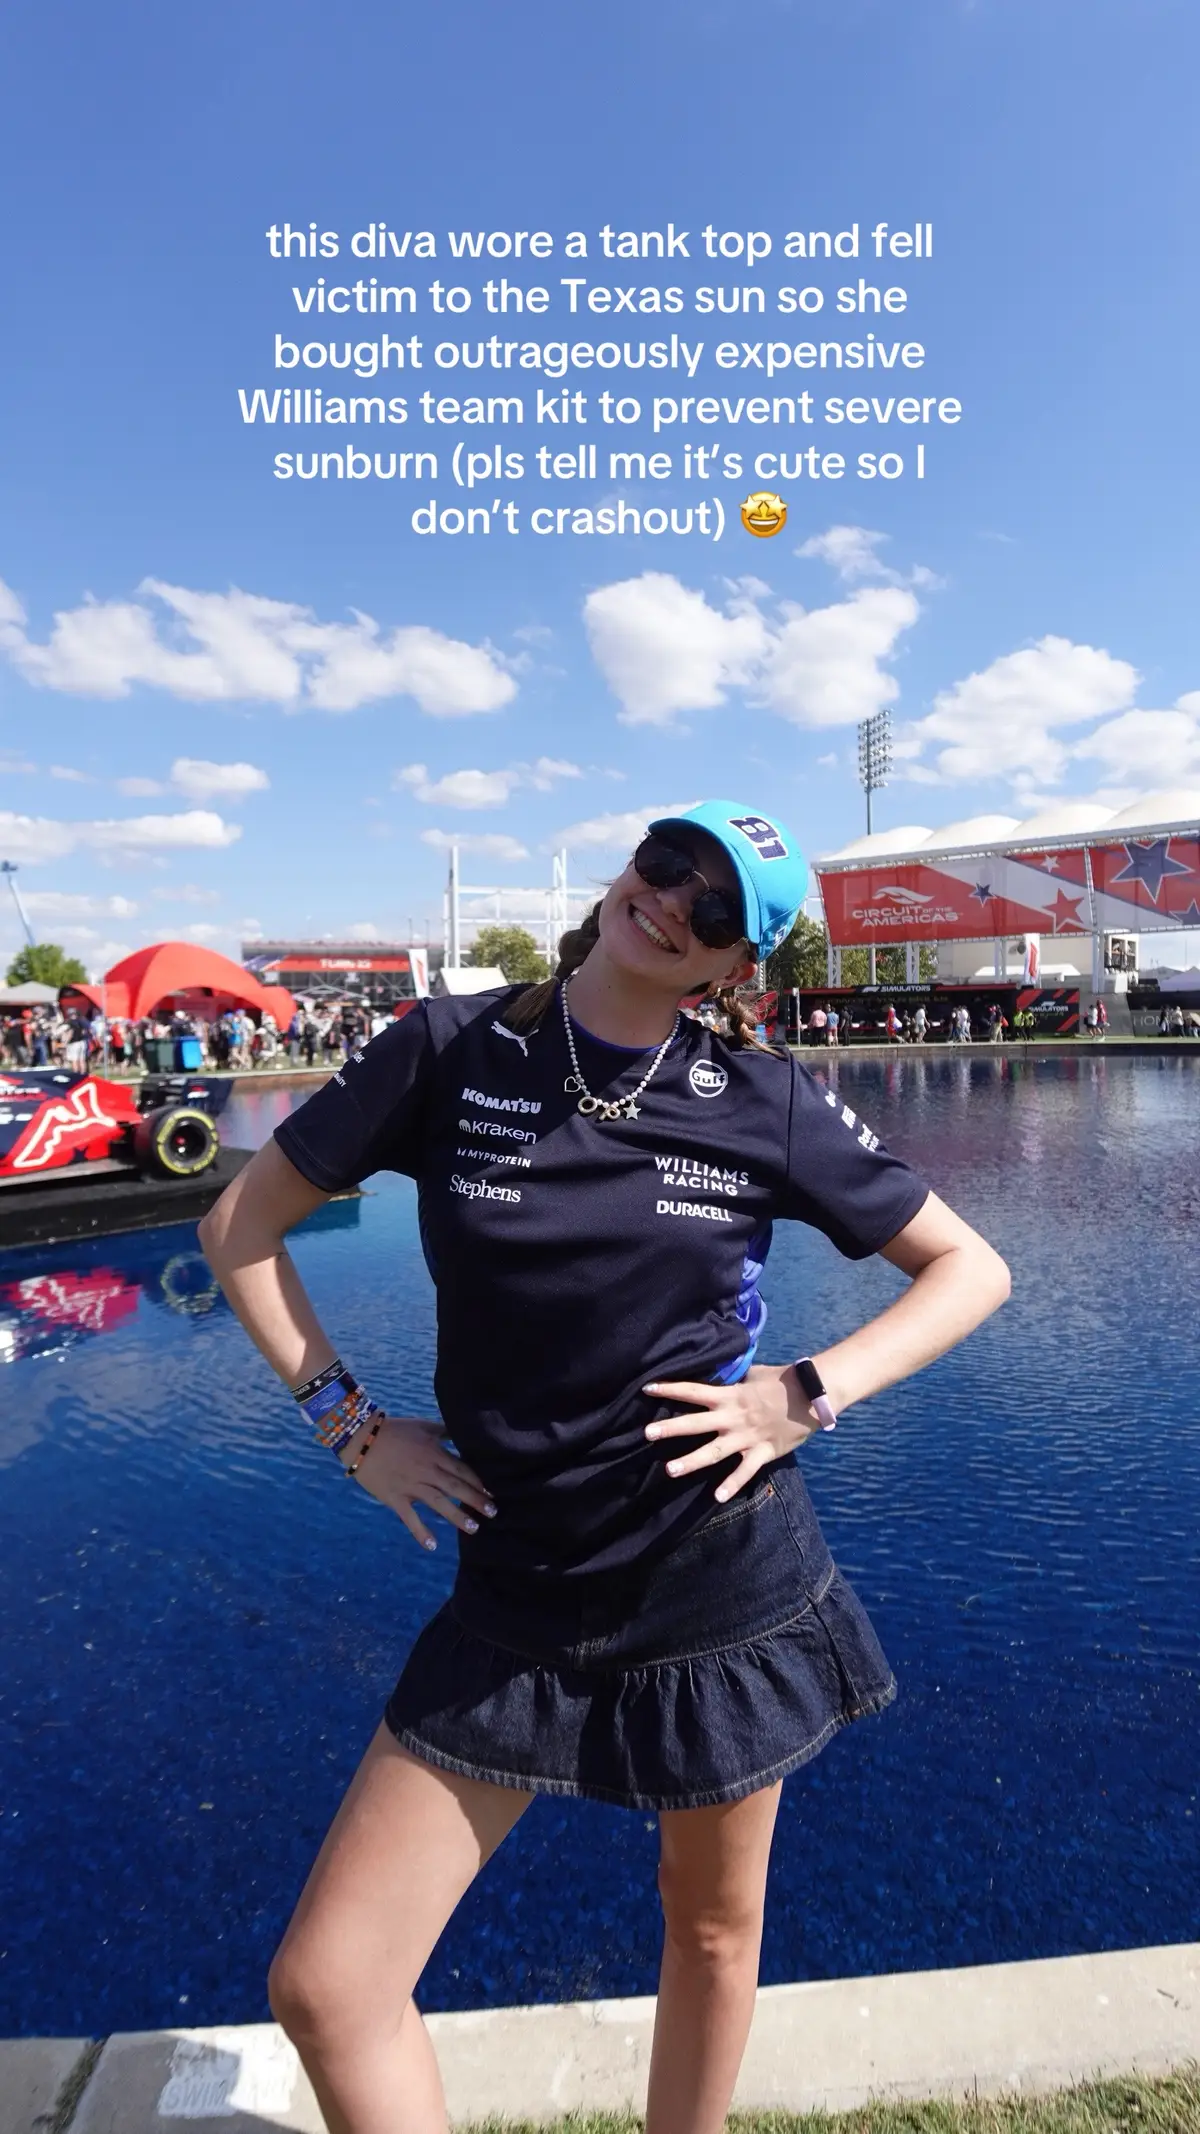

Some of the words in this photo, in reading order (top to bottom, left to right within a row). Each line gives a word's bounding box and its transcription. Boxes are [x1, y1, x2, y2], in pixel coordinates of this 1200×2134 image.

[852, 905, 921, 919] CIRCUIT
[862, 912, 959, 928] AMERICAS
[880, 984, 932, 993] SIMULATORS
[691, 1070, 726, 1085] Gulf
[461, 1087, 542, 1114] KOMATSU
[468, 1149, 532, 1168] MYPROTEIN
[654, 1156, 749, 1186] WILLIAMS
[449, 1174, 522, 1203] Stephens
[663, 1173, 738, 1197] RACING
[656, 1200, 733, 1223] DURACELL
